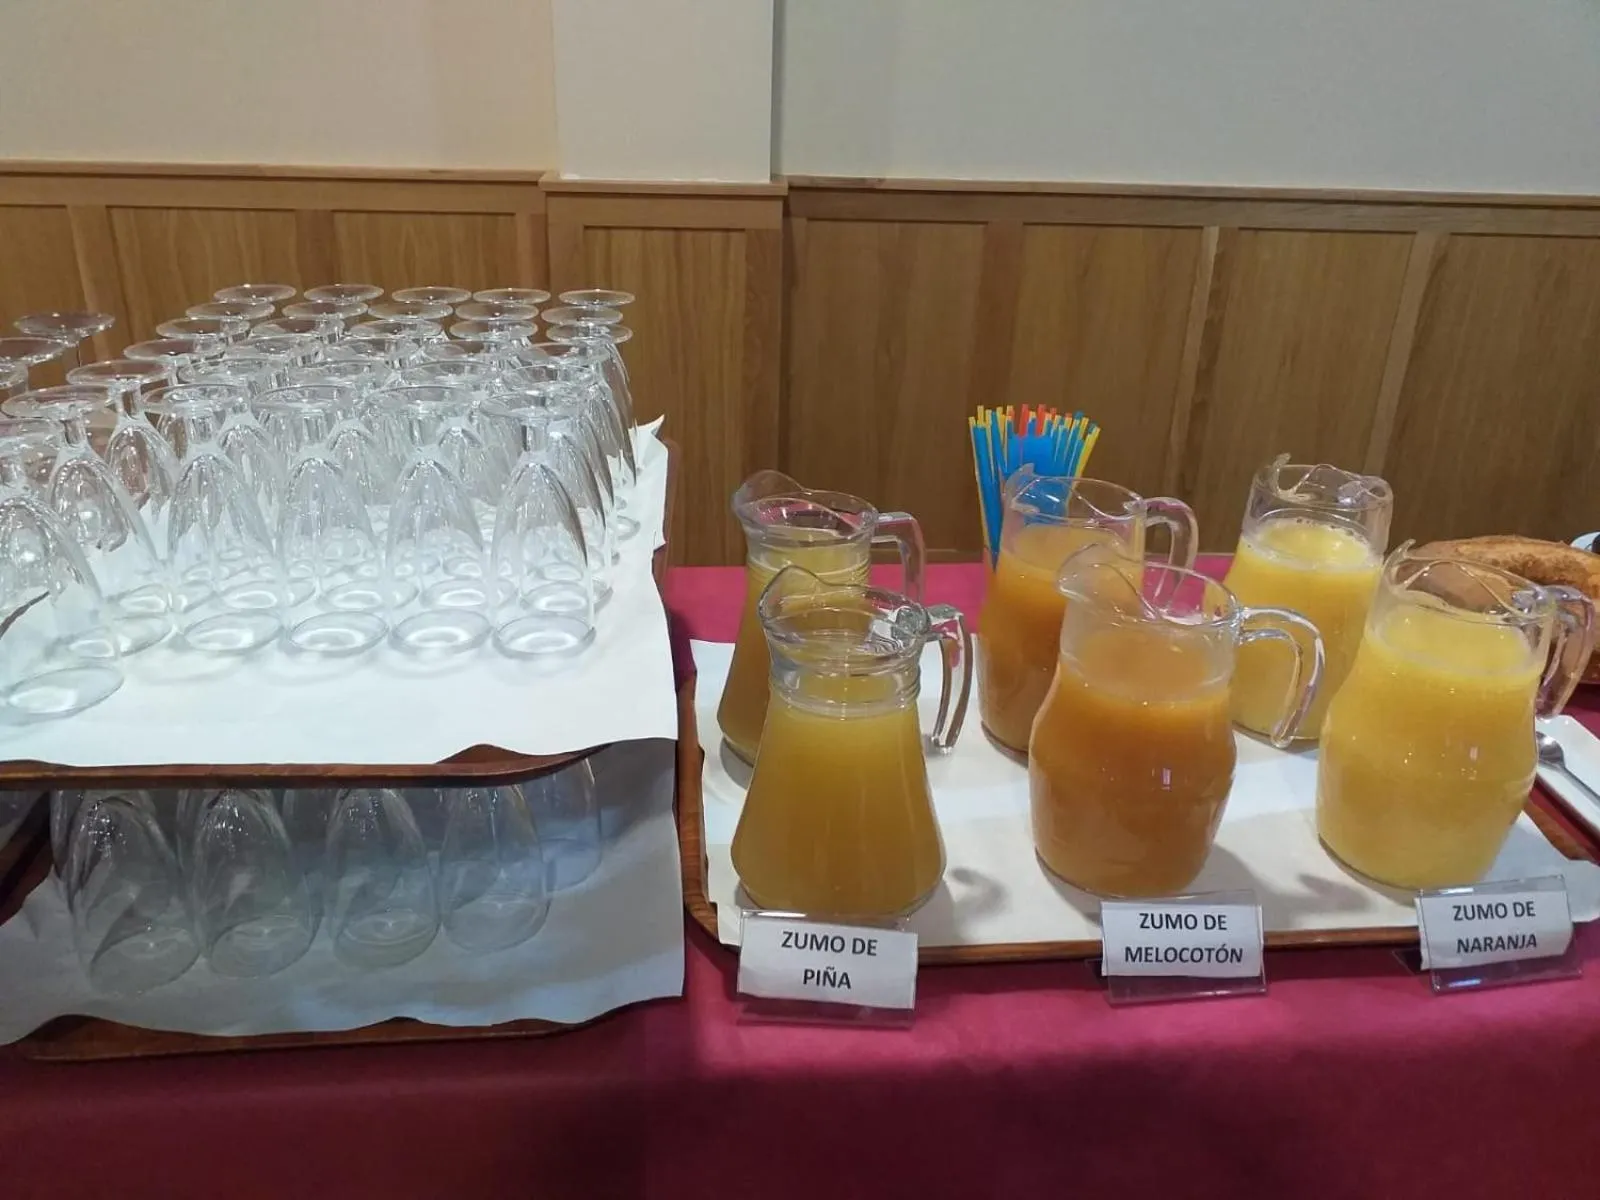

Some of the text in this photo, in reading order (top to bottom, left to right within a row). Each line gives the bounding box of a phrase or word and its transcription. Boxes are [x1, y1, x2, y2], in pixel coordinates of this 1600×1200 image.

[1139, 912, 1229, 931] ZUMO DE
[1452, 900, 1537, 922] ZUMO DE
[781, 930, 879, 957] ZUMO DE
[1124, 943, 1244, 965] MELOCOTÓN
[1456, 933, 1538, 955] NARANJA
[802, 966, 852, 990] PIÑA
